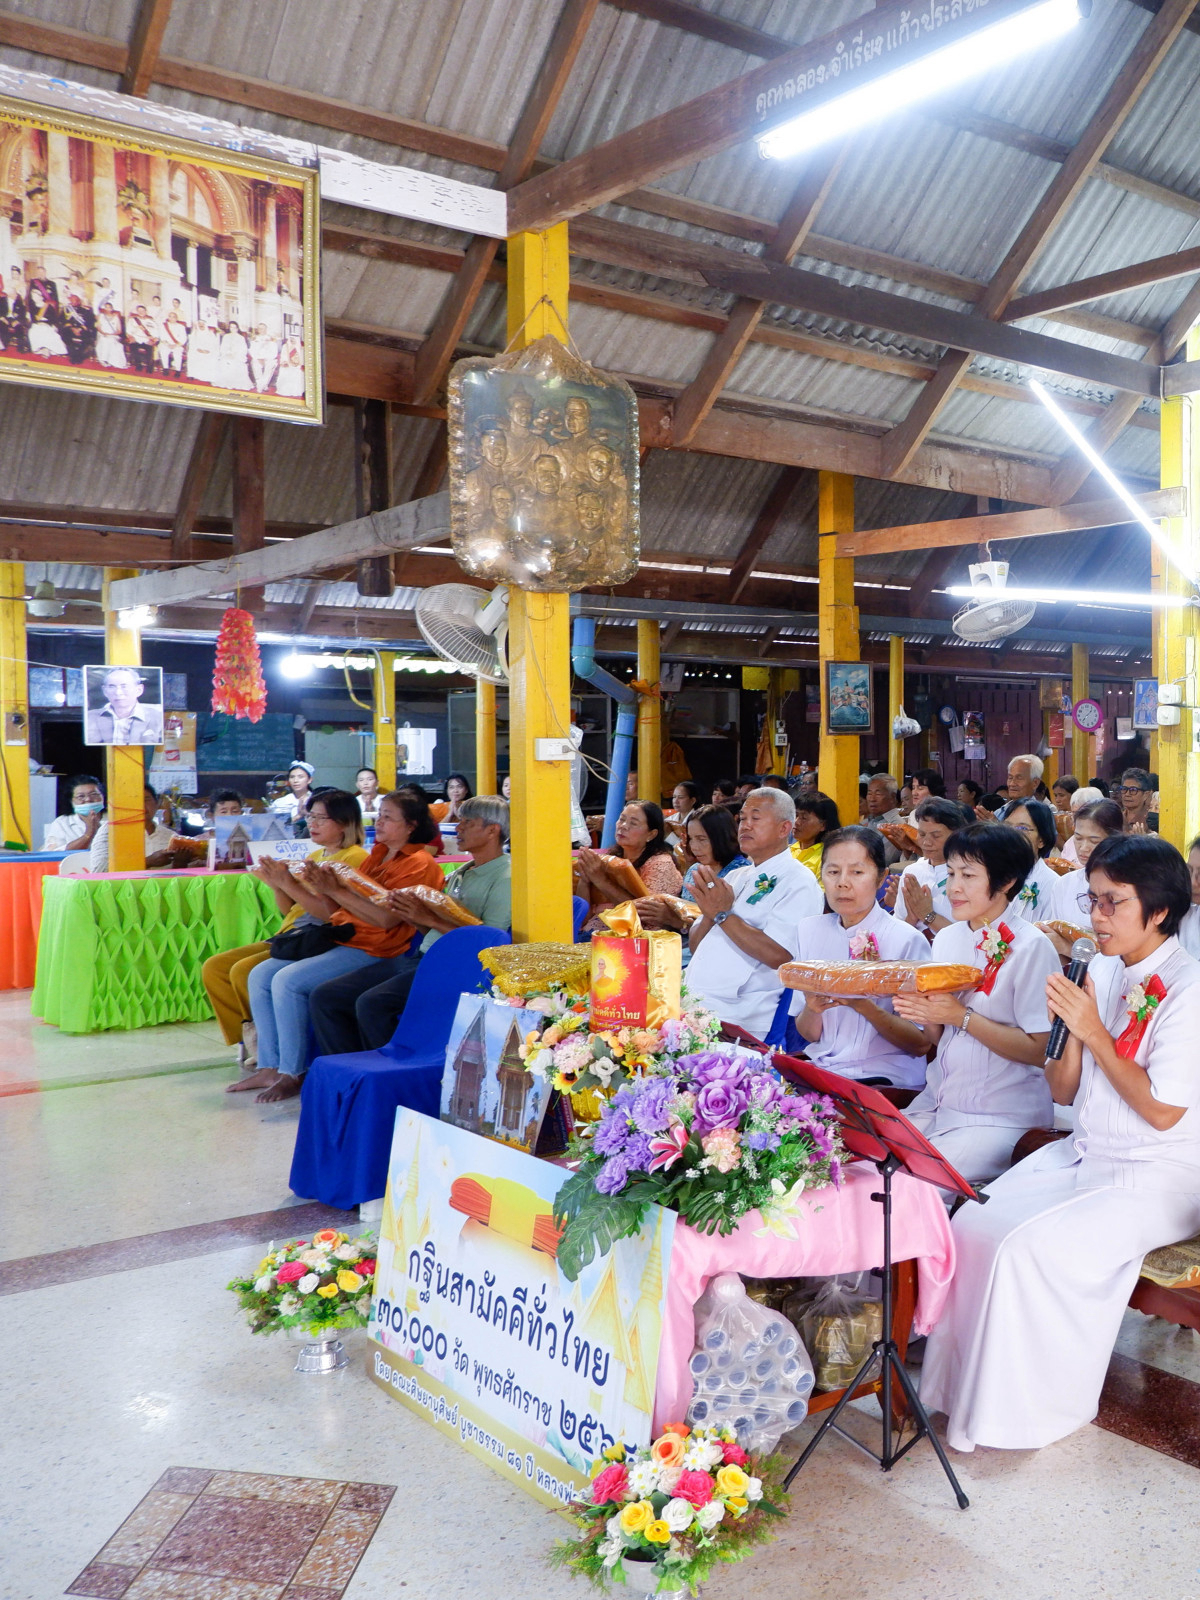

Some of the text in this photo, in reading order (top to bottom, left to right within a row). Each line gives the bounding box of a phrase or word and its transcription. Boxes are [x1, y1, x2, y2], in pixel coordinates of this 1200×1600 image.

[376, 1296, 449, 1362] ๓๐,๐๐๐
[452, 1338, 470, 1374] วัด
[473, 1357, 552, 1428] พุทธศักราช
[407, 1240, 610, 1388] กฐินสามัคคีทั่วไทย
[525, 1458, 535, 1479] ปี
